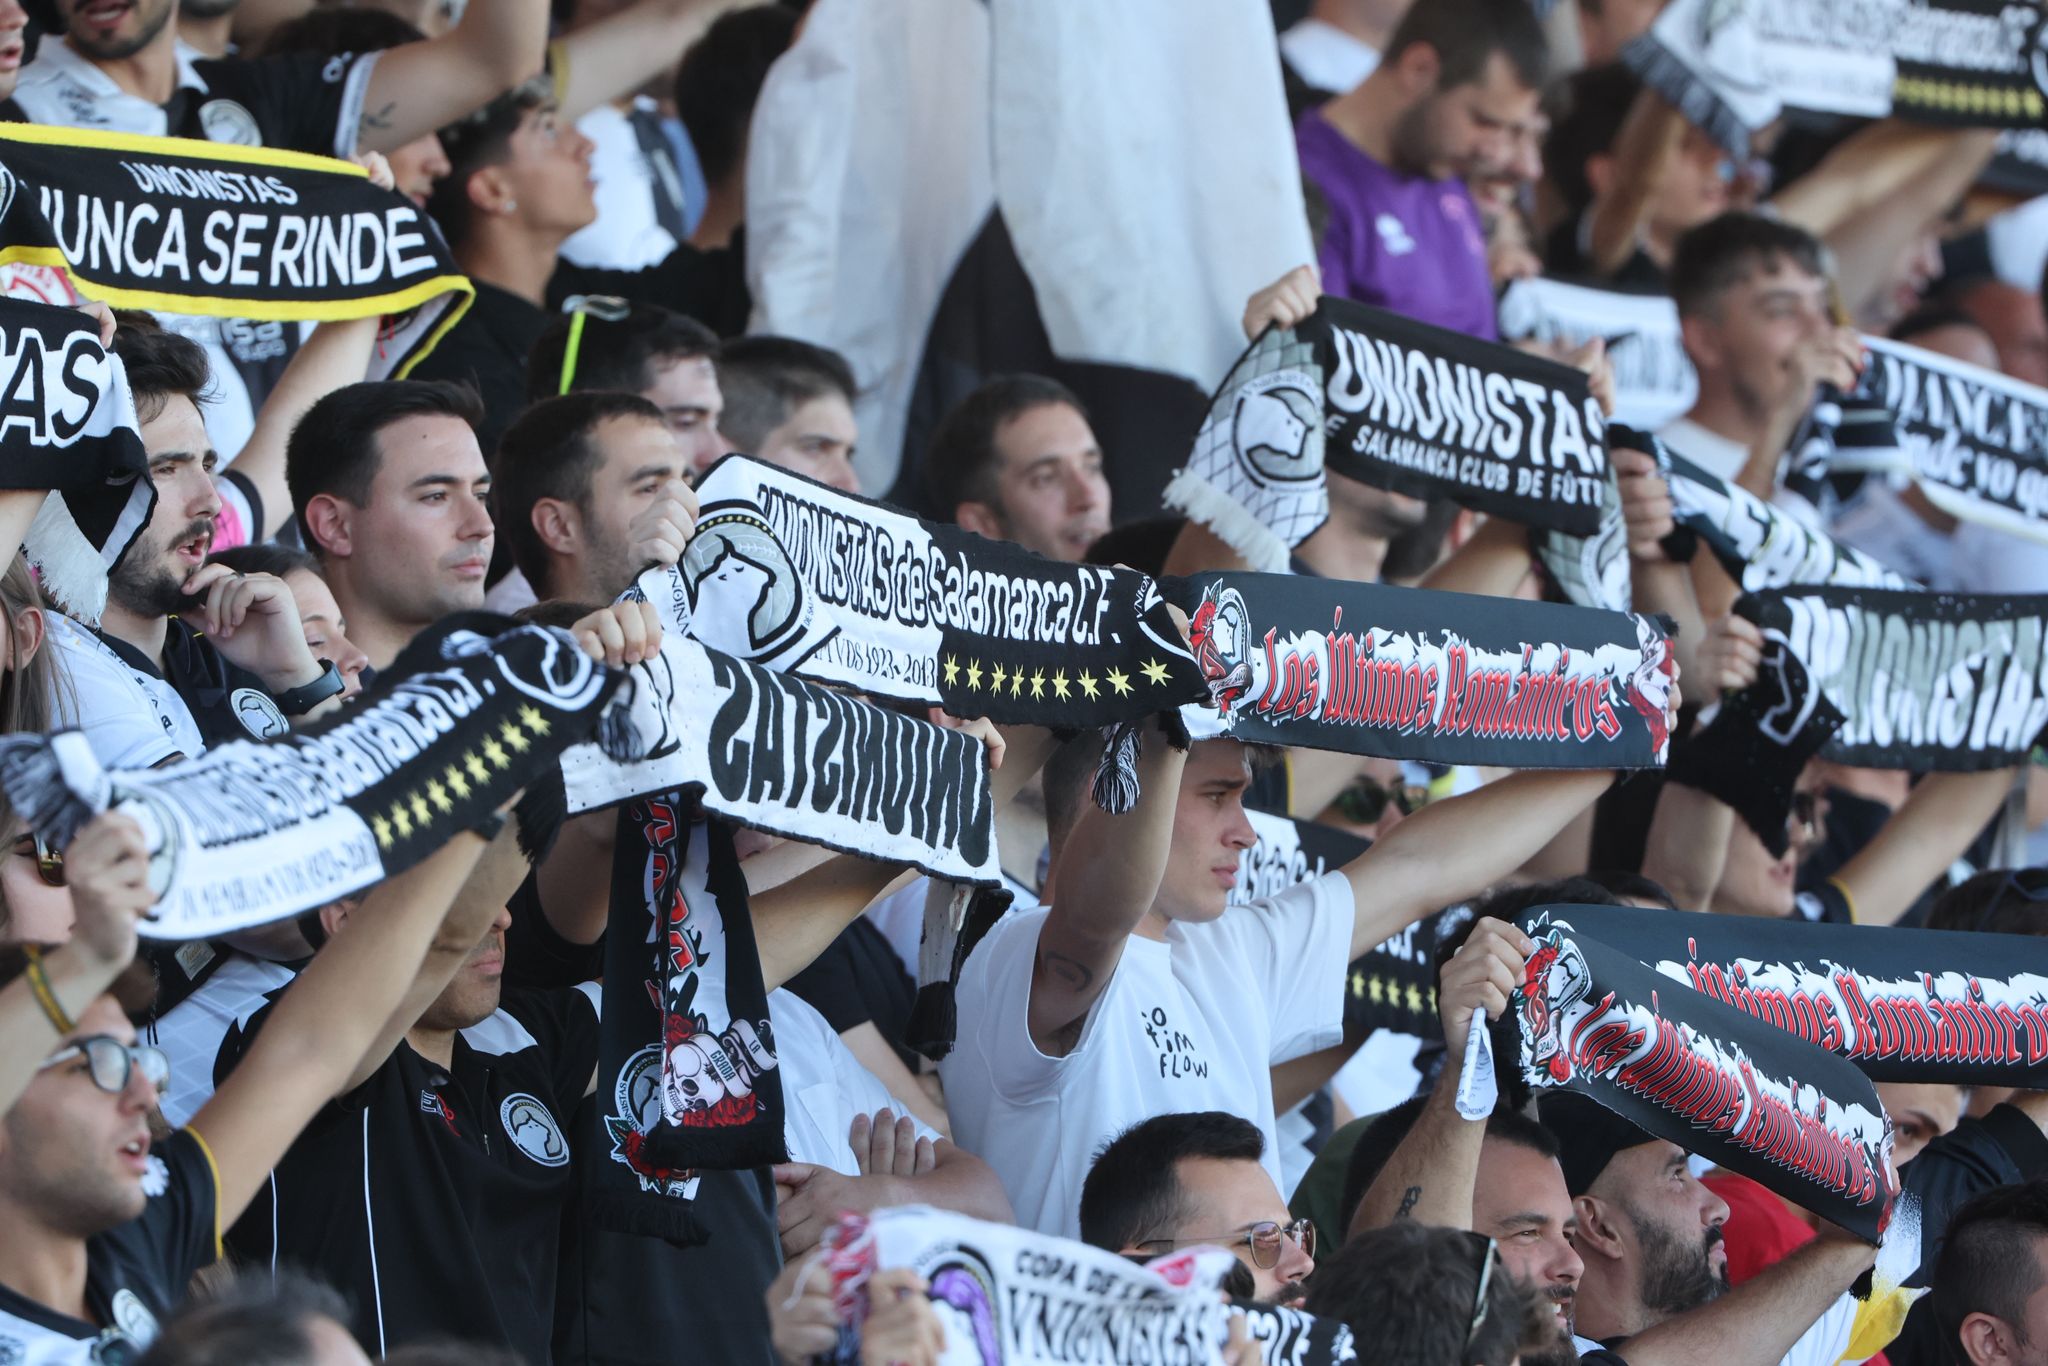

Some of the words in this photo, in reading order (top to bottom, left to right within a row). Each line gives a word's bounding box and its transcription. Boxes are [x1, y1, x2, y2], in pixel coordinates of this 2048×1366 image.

[120, 160, 298, 205] UNIONISTAS
[199, 209, 268, 286] SE
[270, 206, 438, 288] RINDE
[0, 327, 105, 448] AS
[1352, 425, 1460, 482] SALAMANCA
[1459, 452, 1510, 492] CLUB
[1516, 466, 1544, 500] DE
[893, 536, 929, 628] de
[927, 540, 1070, 646] Salamanca
[1073, 566, 1123, 645] C.F.
[1255, 626, 1320, 721] Los
[1434, 642, 1624, 744] Románticos
[709, 1049, 737, 1083] GRADA
[748, 1038, 760, 1055] LA
[1158, 1052, 1209, 1080] FLOW
[1567, 989, 1648, 1080] Los
[1014, 1249, 1077, 1289] COPA
